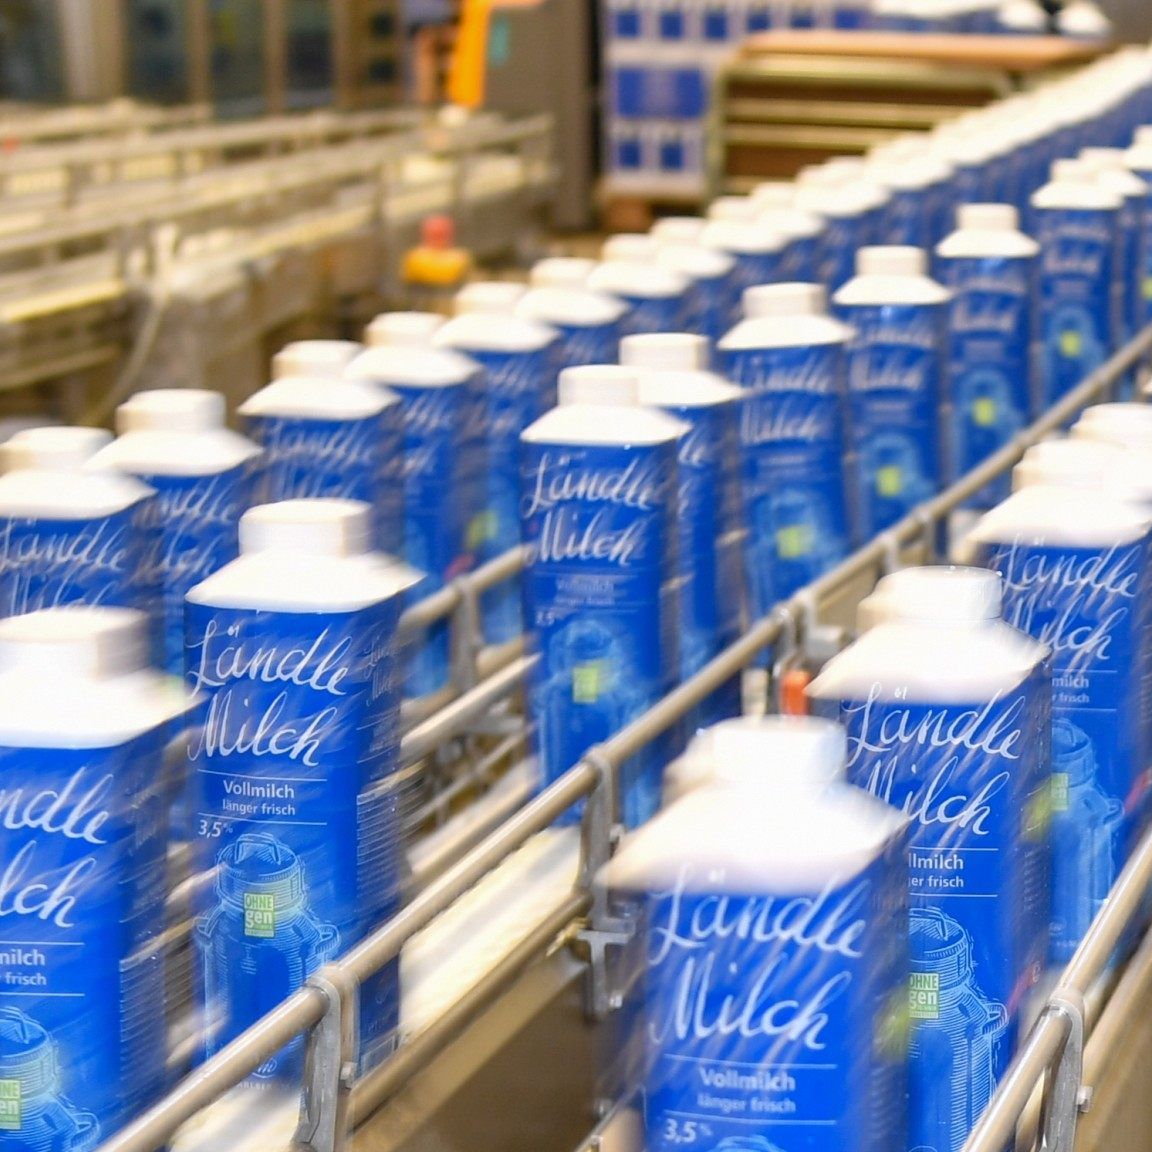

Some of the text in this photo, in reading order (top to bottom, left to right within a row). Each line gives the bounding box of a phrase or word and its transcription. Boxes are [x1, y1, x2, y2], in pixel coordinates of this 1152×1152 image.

[520, 450, 660, 520] Ländle
[524, 503, 650, 568] Milch
[185, 618, 353, 699] Ländle
[186, 690, 338, 767] Milch
[842, 681, 1025, 769] Ländle
[222, 779, 295, 799] Vollmilch
[222, 798, 296, 816] länger frisch
[927, 875, 964, 888] frisch
[244, 910, 272, 928] gen
[650, 862, 873, 967] Ländle
[5, 970, 47, 986] frisch
[648, 951, 852, 1051] Milch
[699, 1068, 796, 1093] Vollmilch
